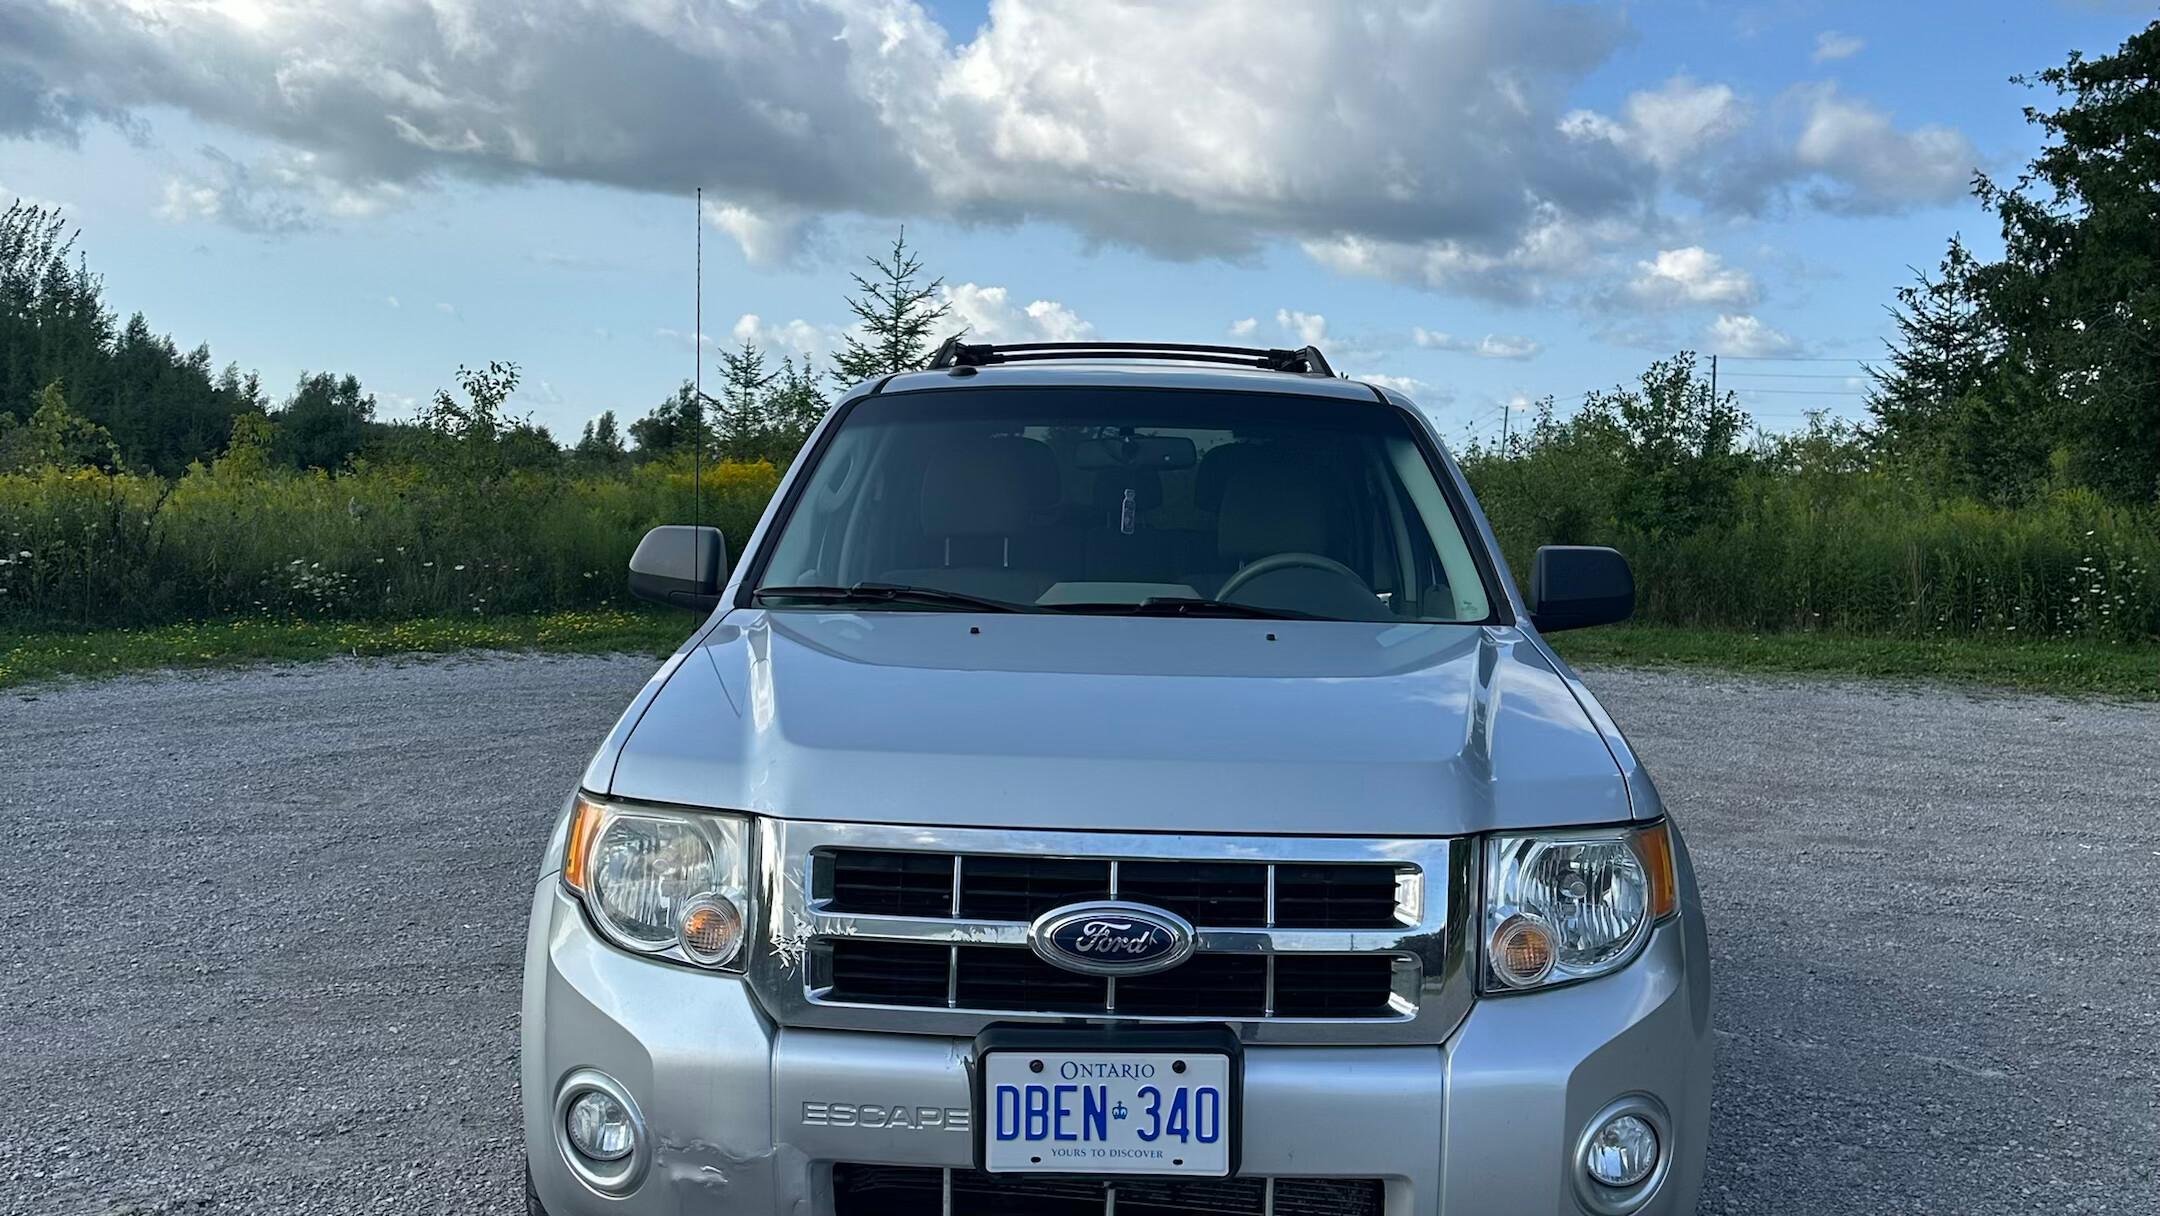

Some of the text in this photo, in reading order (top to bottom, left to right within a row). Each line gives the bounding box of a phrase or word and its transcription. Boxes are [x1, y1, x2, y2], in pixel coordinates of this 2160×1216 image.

[1075, 921, 1151, 954] Ford
[1060, 1061, 1155, 1081] ONTARIO
[801, 1101, 969, 1131] ESCAPE
[996, 1084, 1220, 1144] DBEN 340
[1051, 1148, 1164, 1159] YOURS TO DISCOVER
